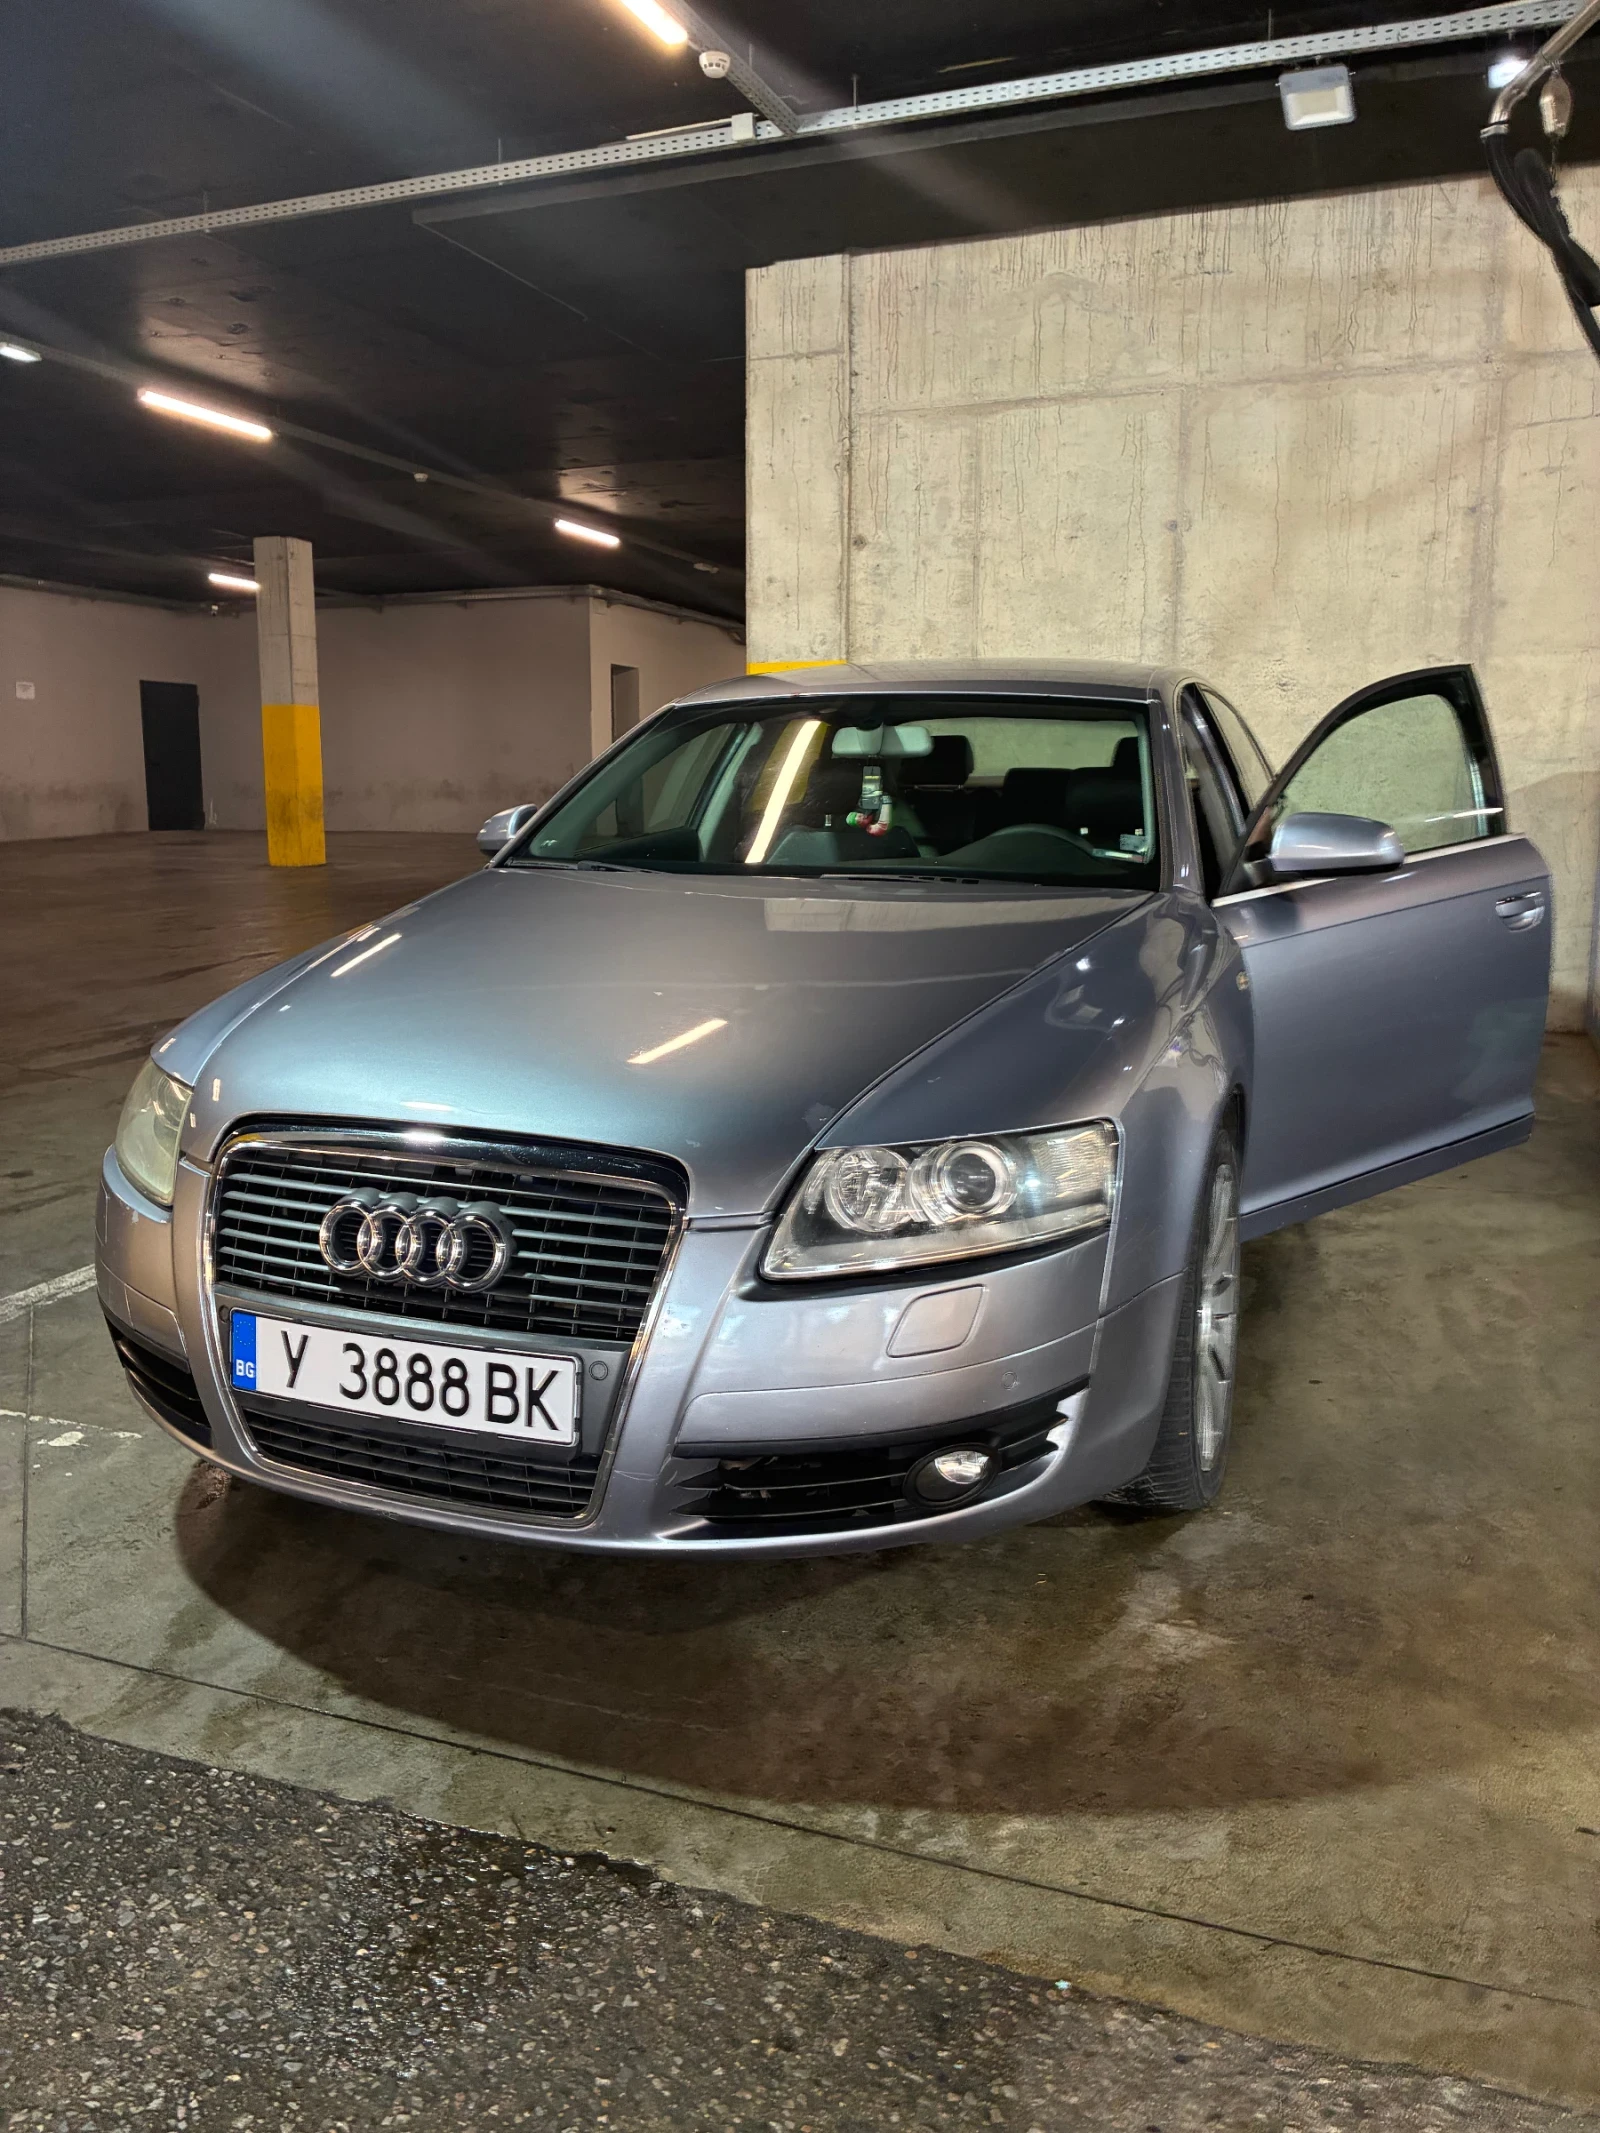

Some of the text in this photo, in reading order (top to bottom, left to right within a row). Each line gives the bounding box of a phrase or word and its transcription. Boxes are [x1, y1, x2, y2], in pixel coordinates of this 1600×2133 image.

[236, 1359, 255, 1378] BG
[339, 1343, 470, 1417] 3888
[484, 1362, 561, 1431] BK
